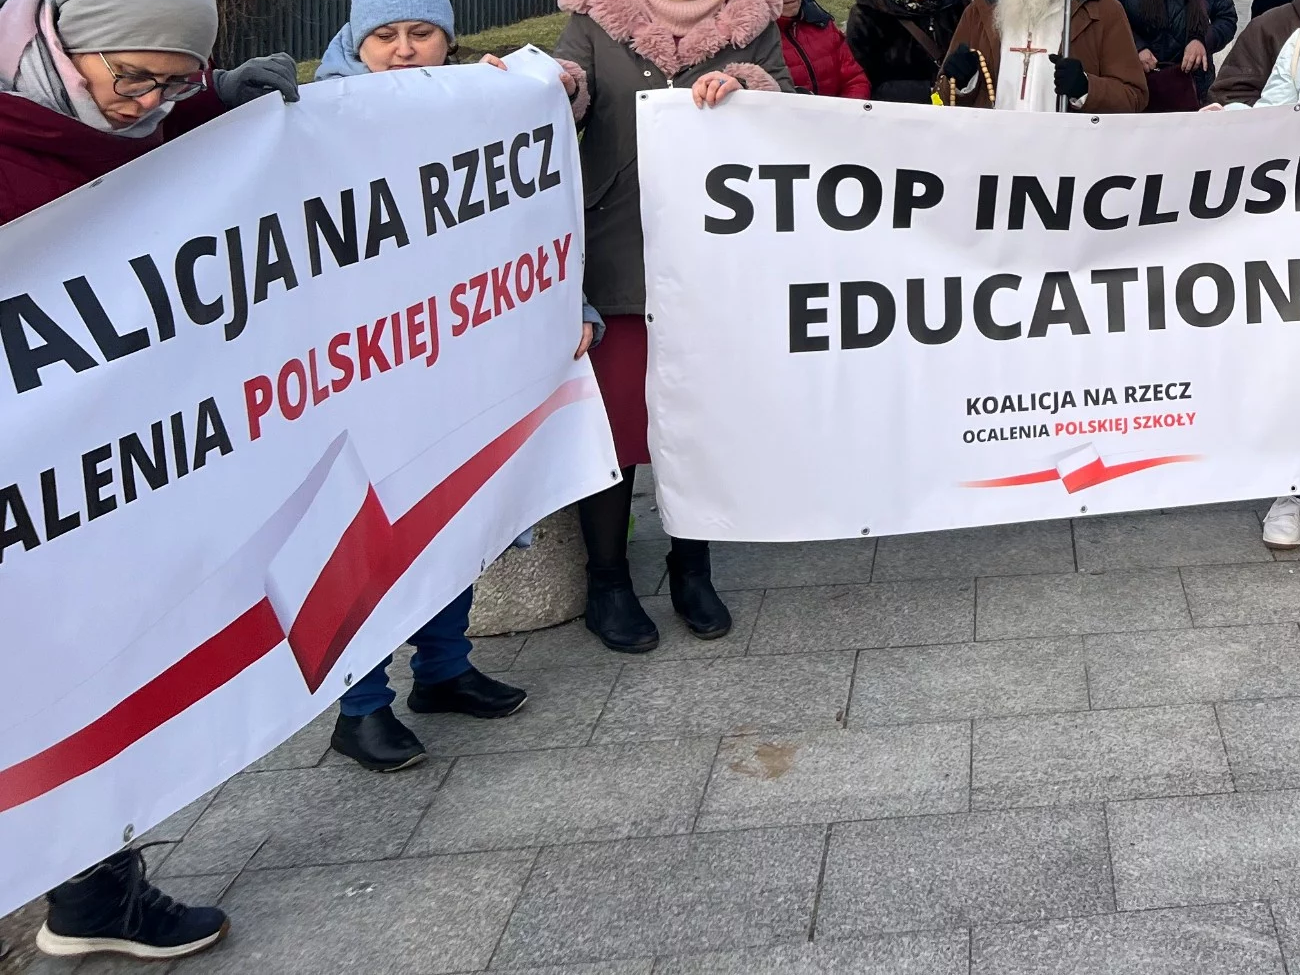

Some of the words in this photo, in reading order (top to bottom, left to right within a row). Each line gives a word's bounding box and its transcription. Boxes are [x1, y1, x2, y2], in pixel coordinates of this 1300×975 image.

[304, 177, 410, 277] NA
[418, 123, 561, 237] RZECZ
[704, 163, 945, 235] STOP
[243, 296, 441, 441] POLSKIEJ
[450, 233, 572, 337] SZKOŁY
[962, 423, 1050, 444] OCALENIA
[1054, 416, 1129, 437] POLSKIEJ
[1132, 411, 1197, 431] SZKOŁY
[966, 390, 1077, 417] KOALICJA
[1083, 387, 1118, 407] NA
[1124, 381, 1192, 404] RZECZ
